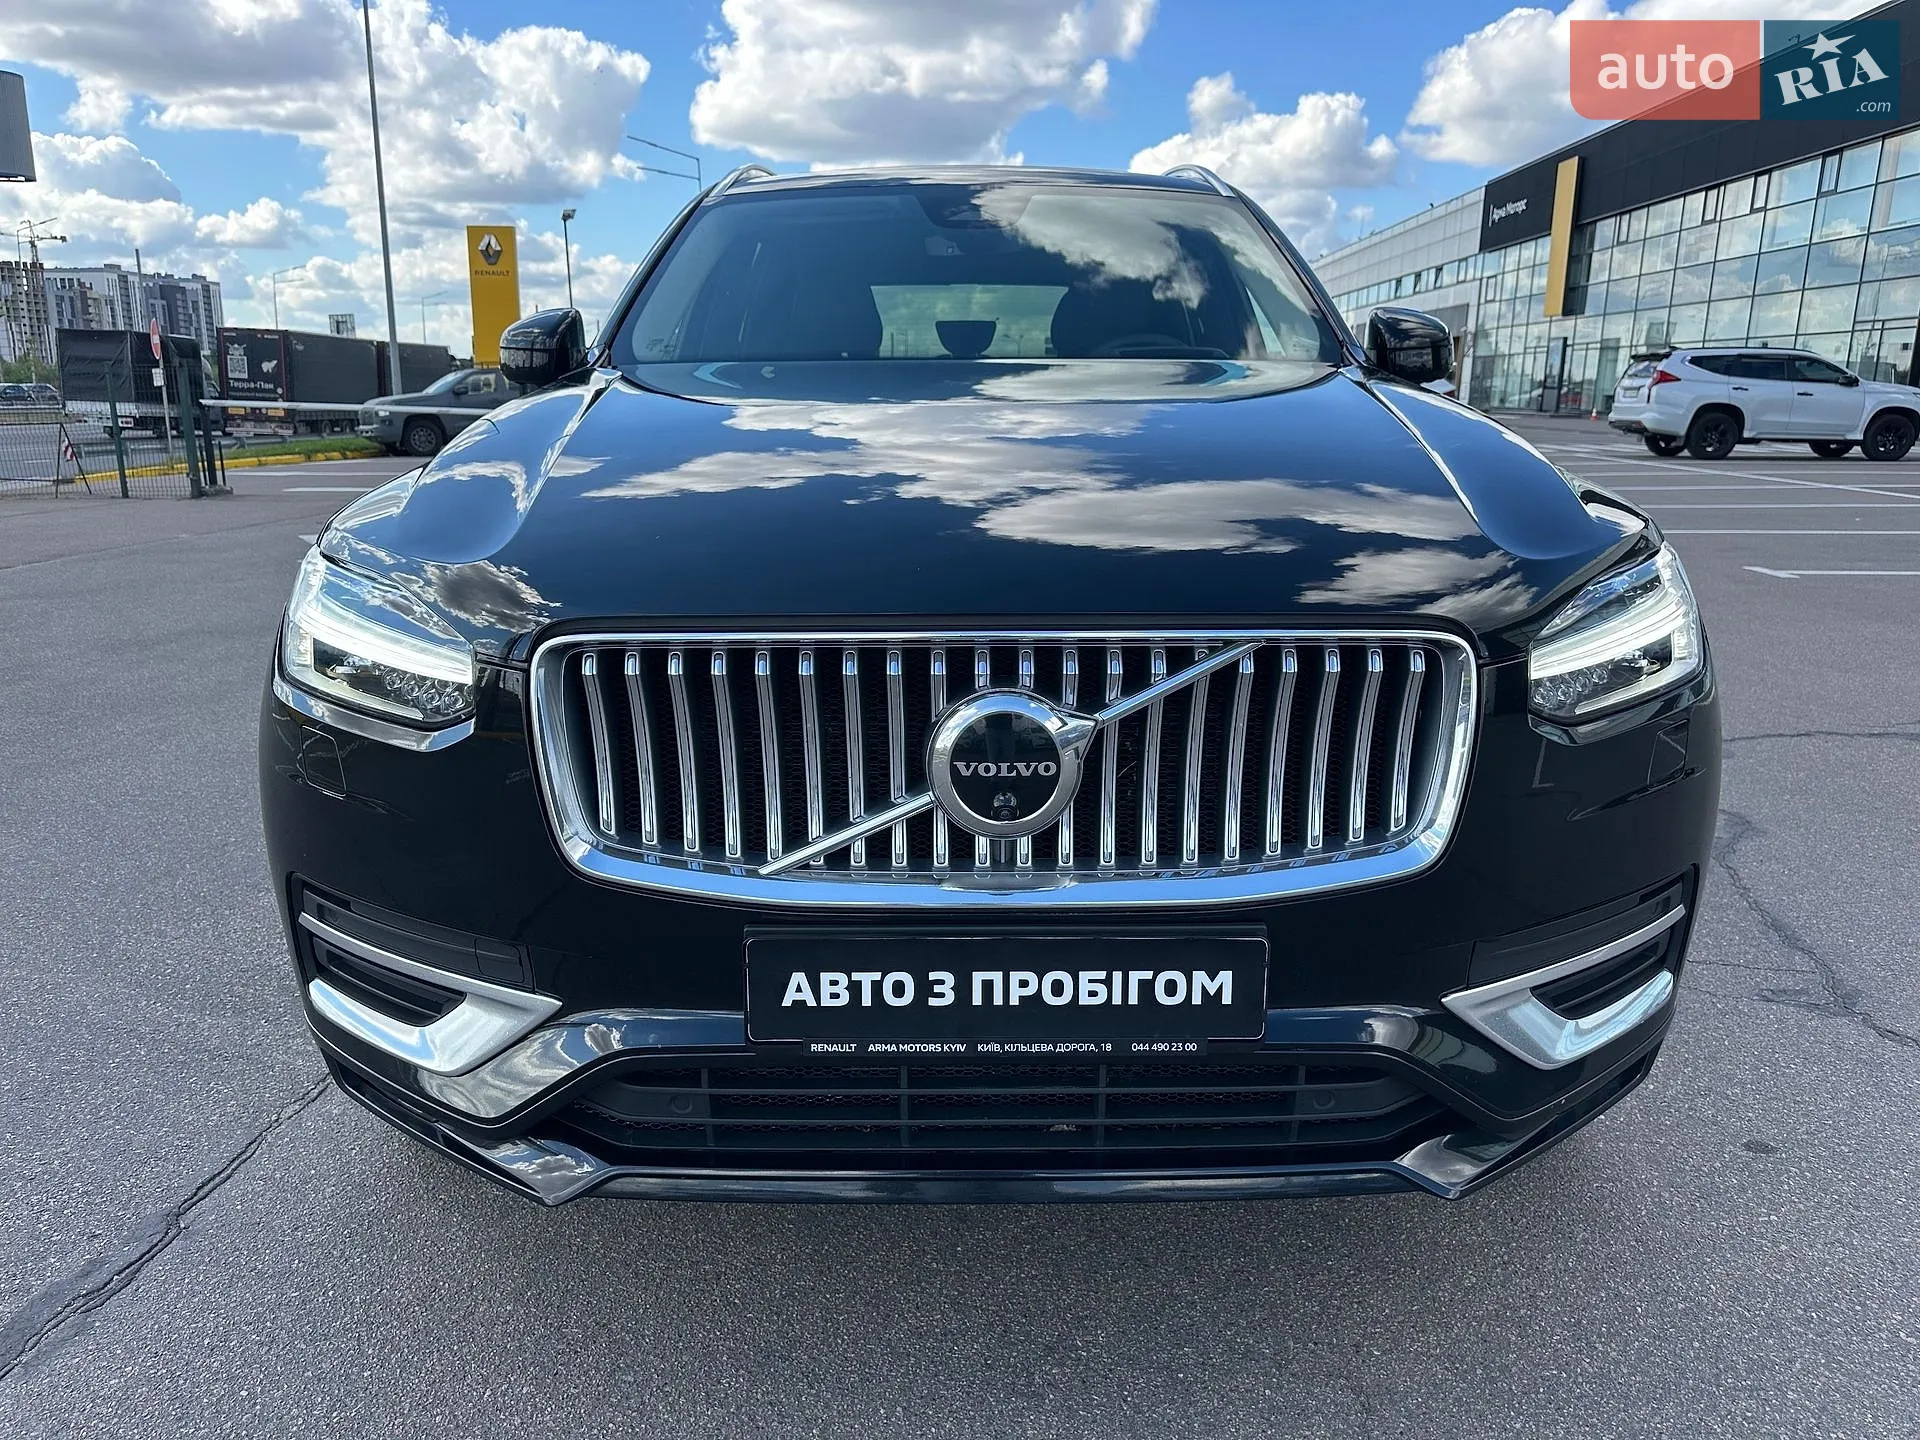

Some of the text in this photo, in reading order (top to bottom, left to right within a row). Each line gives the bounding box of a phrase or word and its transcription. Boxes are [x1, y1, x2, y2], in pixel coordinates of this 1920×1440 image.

[953, 761, 1057, 777] VOLVO
[781, 971, 916, 1007] АВТО
[971, 970, 1234, 1006] ПРОБІГОМ
[810, 1042, 1197, 1053] RENAULT ARMA MOTORS KYIV КИЇВ, КІЛЬЦЕВА ДОРОГА, 18 044 490 23 00
